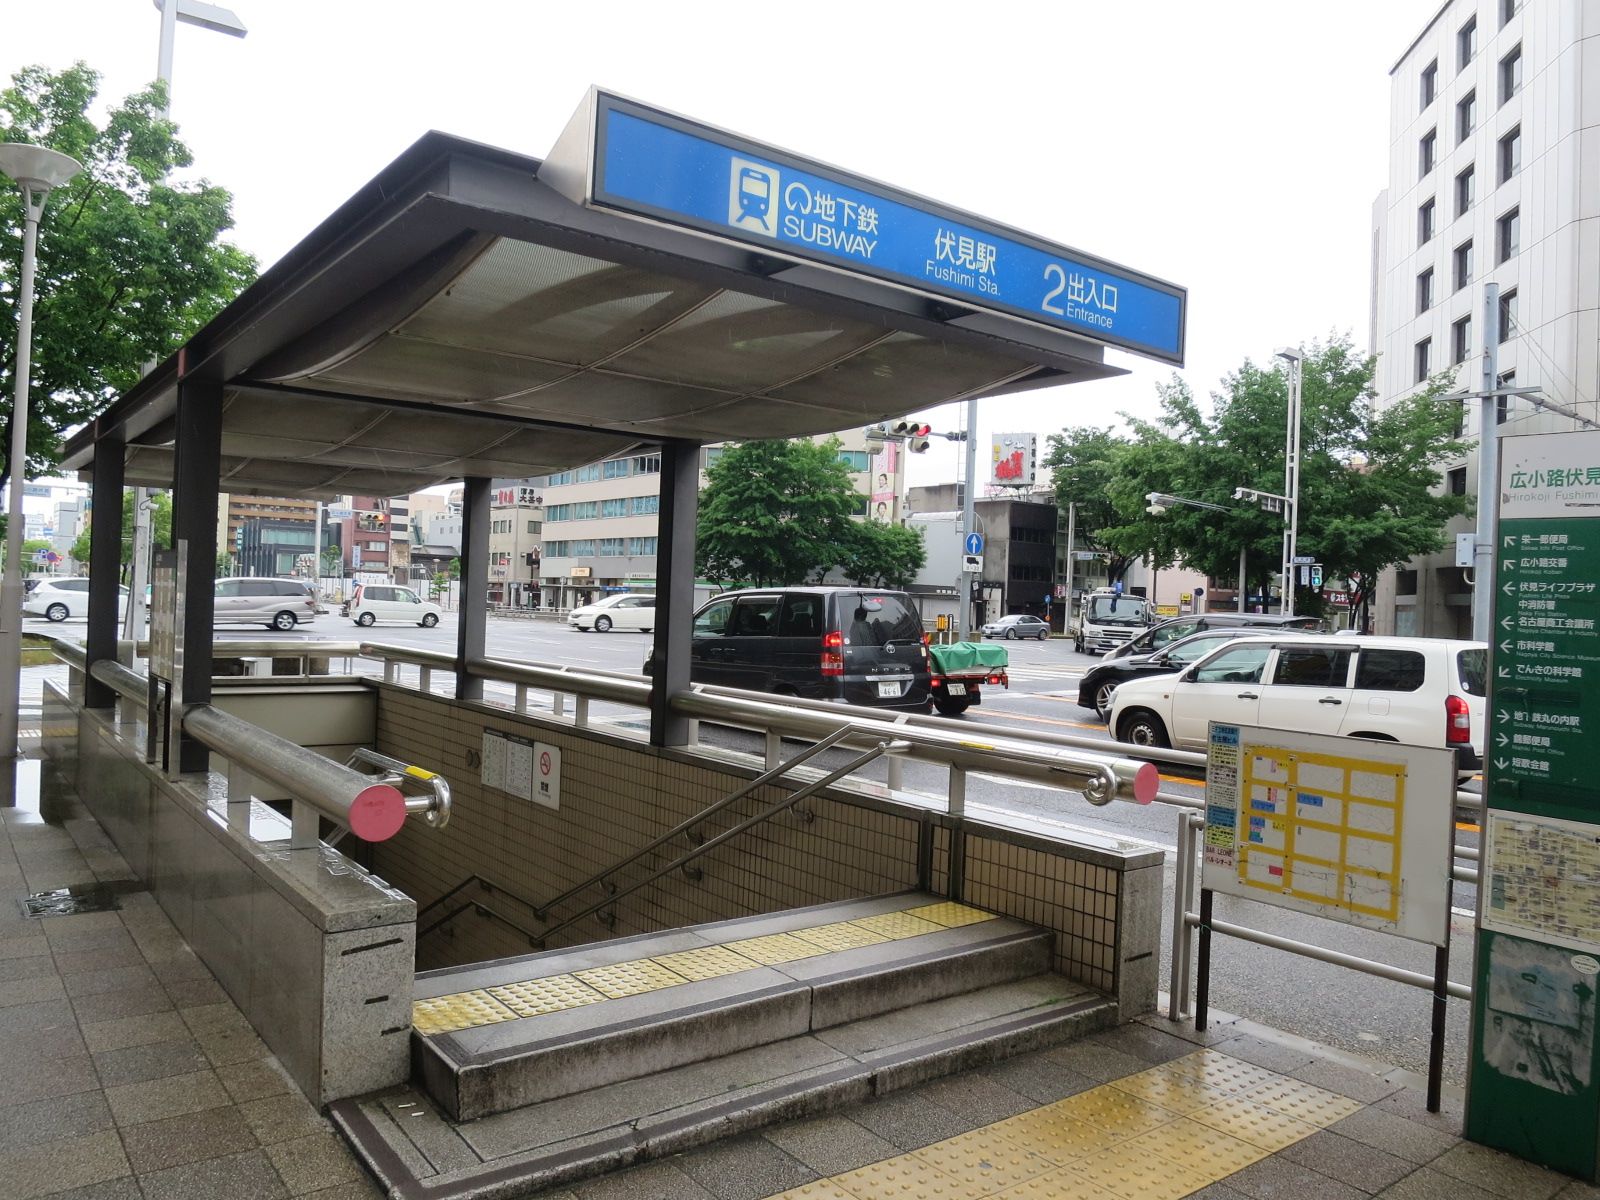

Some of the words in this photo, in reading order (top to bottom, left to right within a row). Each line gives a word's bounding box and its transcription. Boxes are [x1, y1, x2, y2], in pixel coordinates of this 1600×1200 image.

[783, 214, 878, 259] SUBWAY
[934, 227, 997, 277] 伏見駅
[926, 259, 975, 289] Fushimi
[978, 275, 1001, 296] Sta.
[1041, 263, 1066, 316] 2
[1067, 272, 1118, 314] 出入口
[1066, 302, 1113, 329] Entrance
[1509, 466, 1600, 489] 広小路伏見
[1520, 558, 1568, 568] 広小路交番
[1518, 616, 1595, 630] 名古屋商工会議所
[1516, 640, 1555, 652] 市科学館
